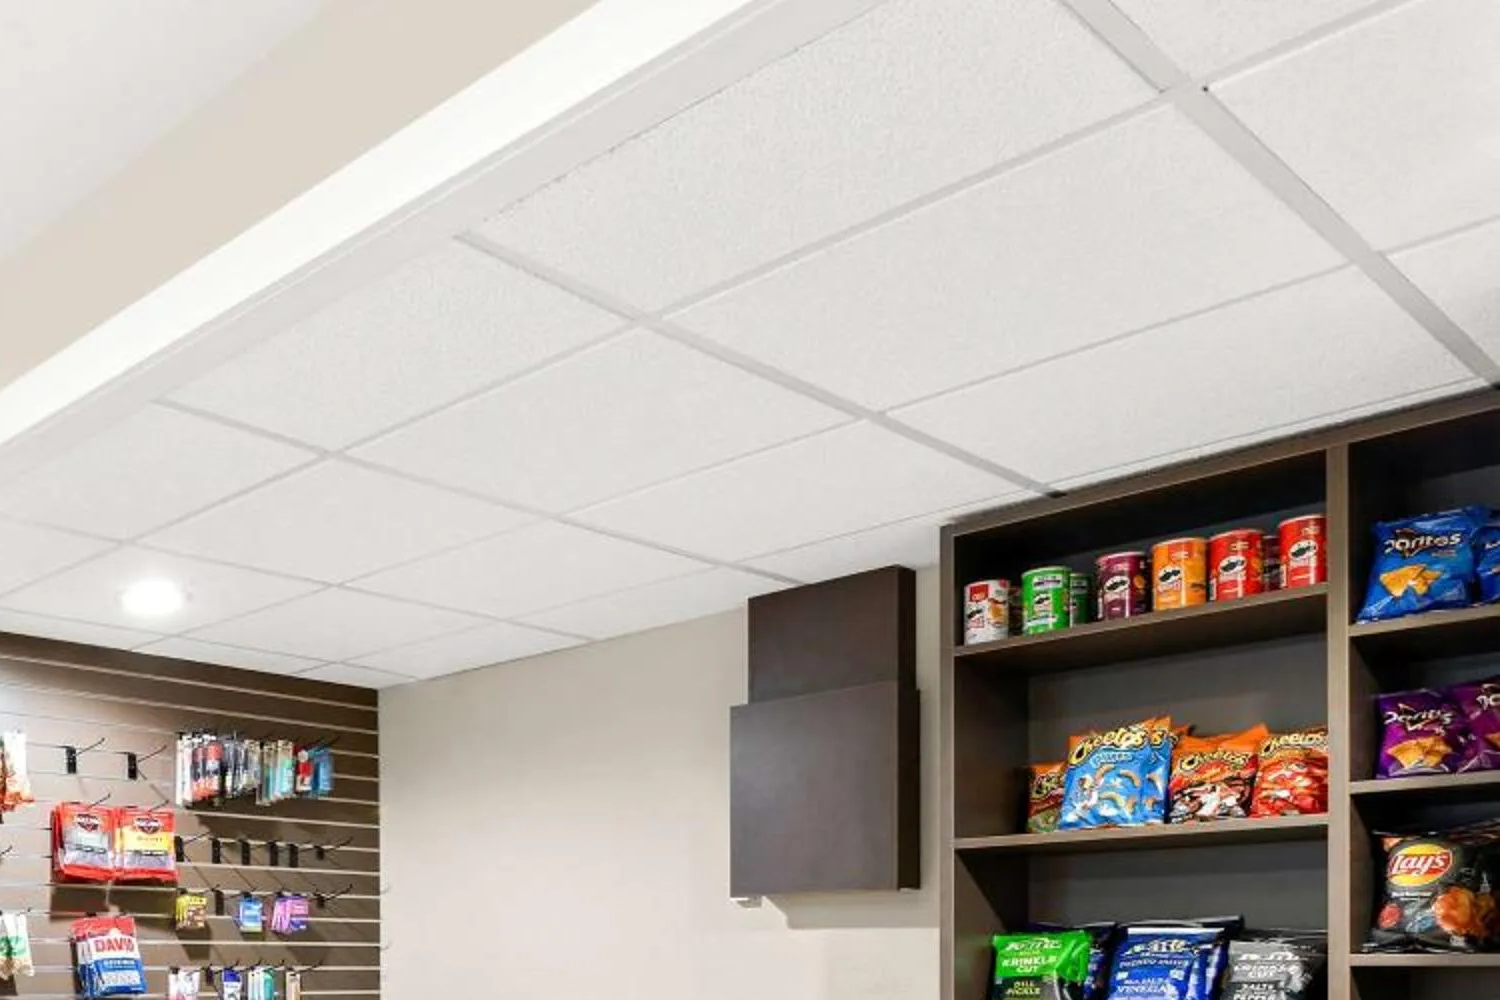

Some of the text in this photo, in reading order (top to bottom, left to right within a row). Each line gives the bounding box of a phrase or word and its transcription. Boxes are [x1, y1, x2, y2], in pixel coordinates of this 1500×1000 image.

[1384, 532, 1461, 556] Doritos
[1384, 709, 1453, 726] Doritos
[1069, 727, 1147, 765] Cheetos
[1260, 731, 1326, 756] Cheetos
[1179, 751, 1252, 770] Cheetos
